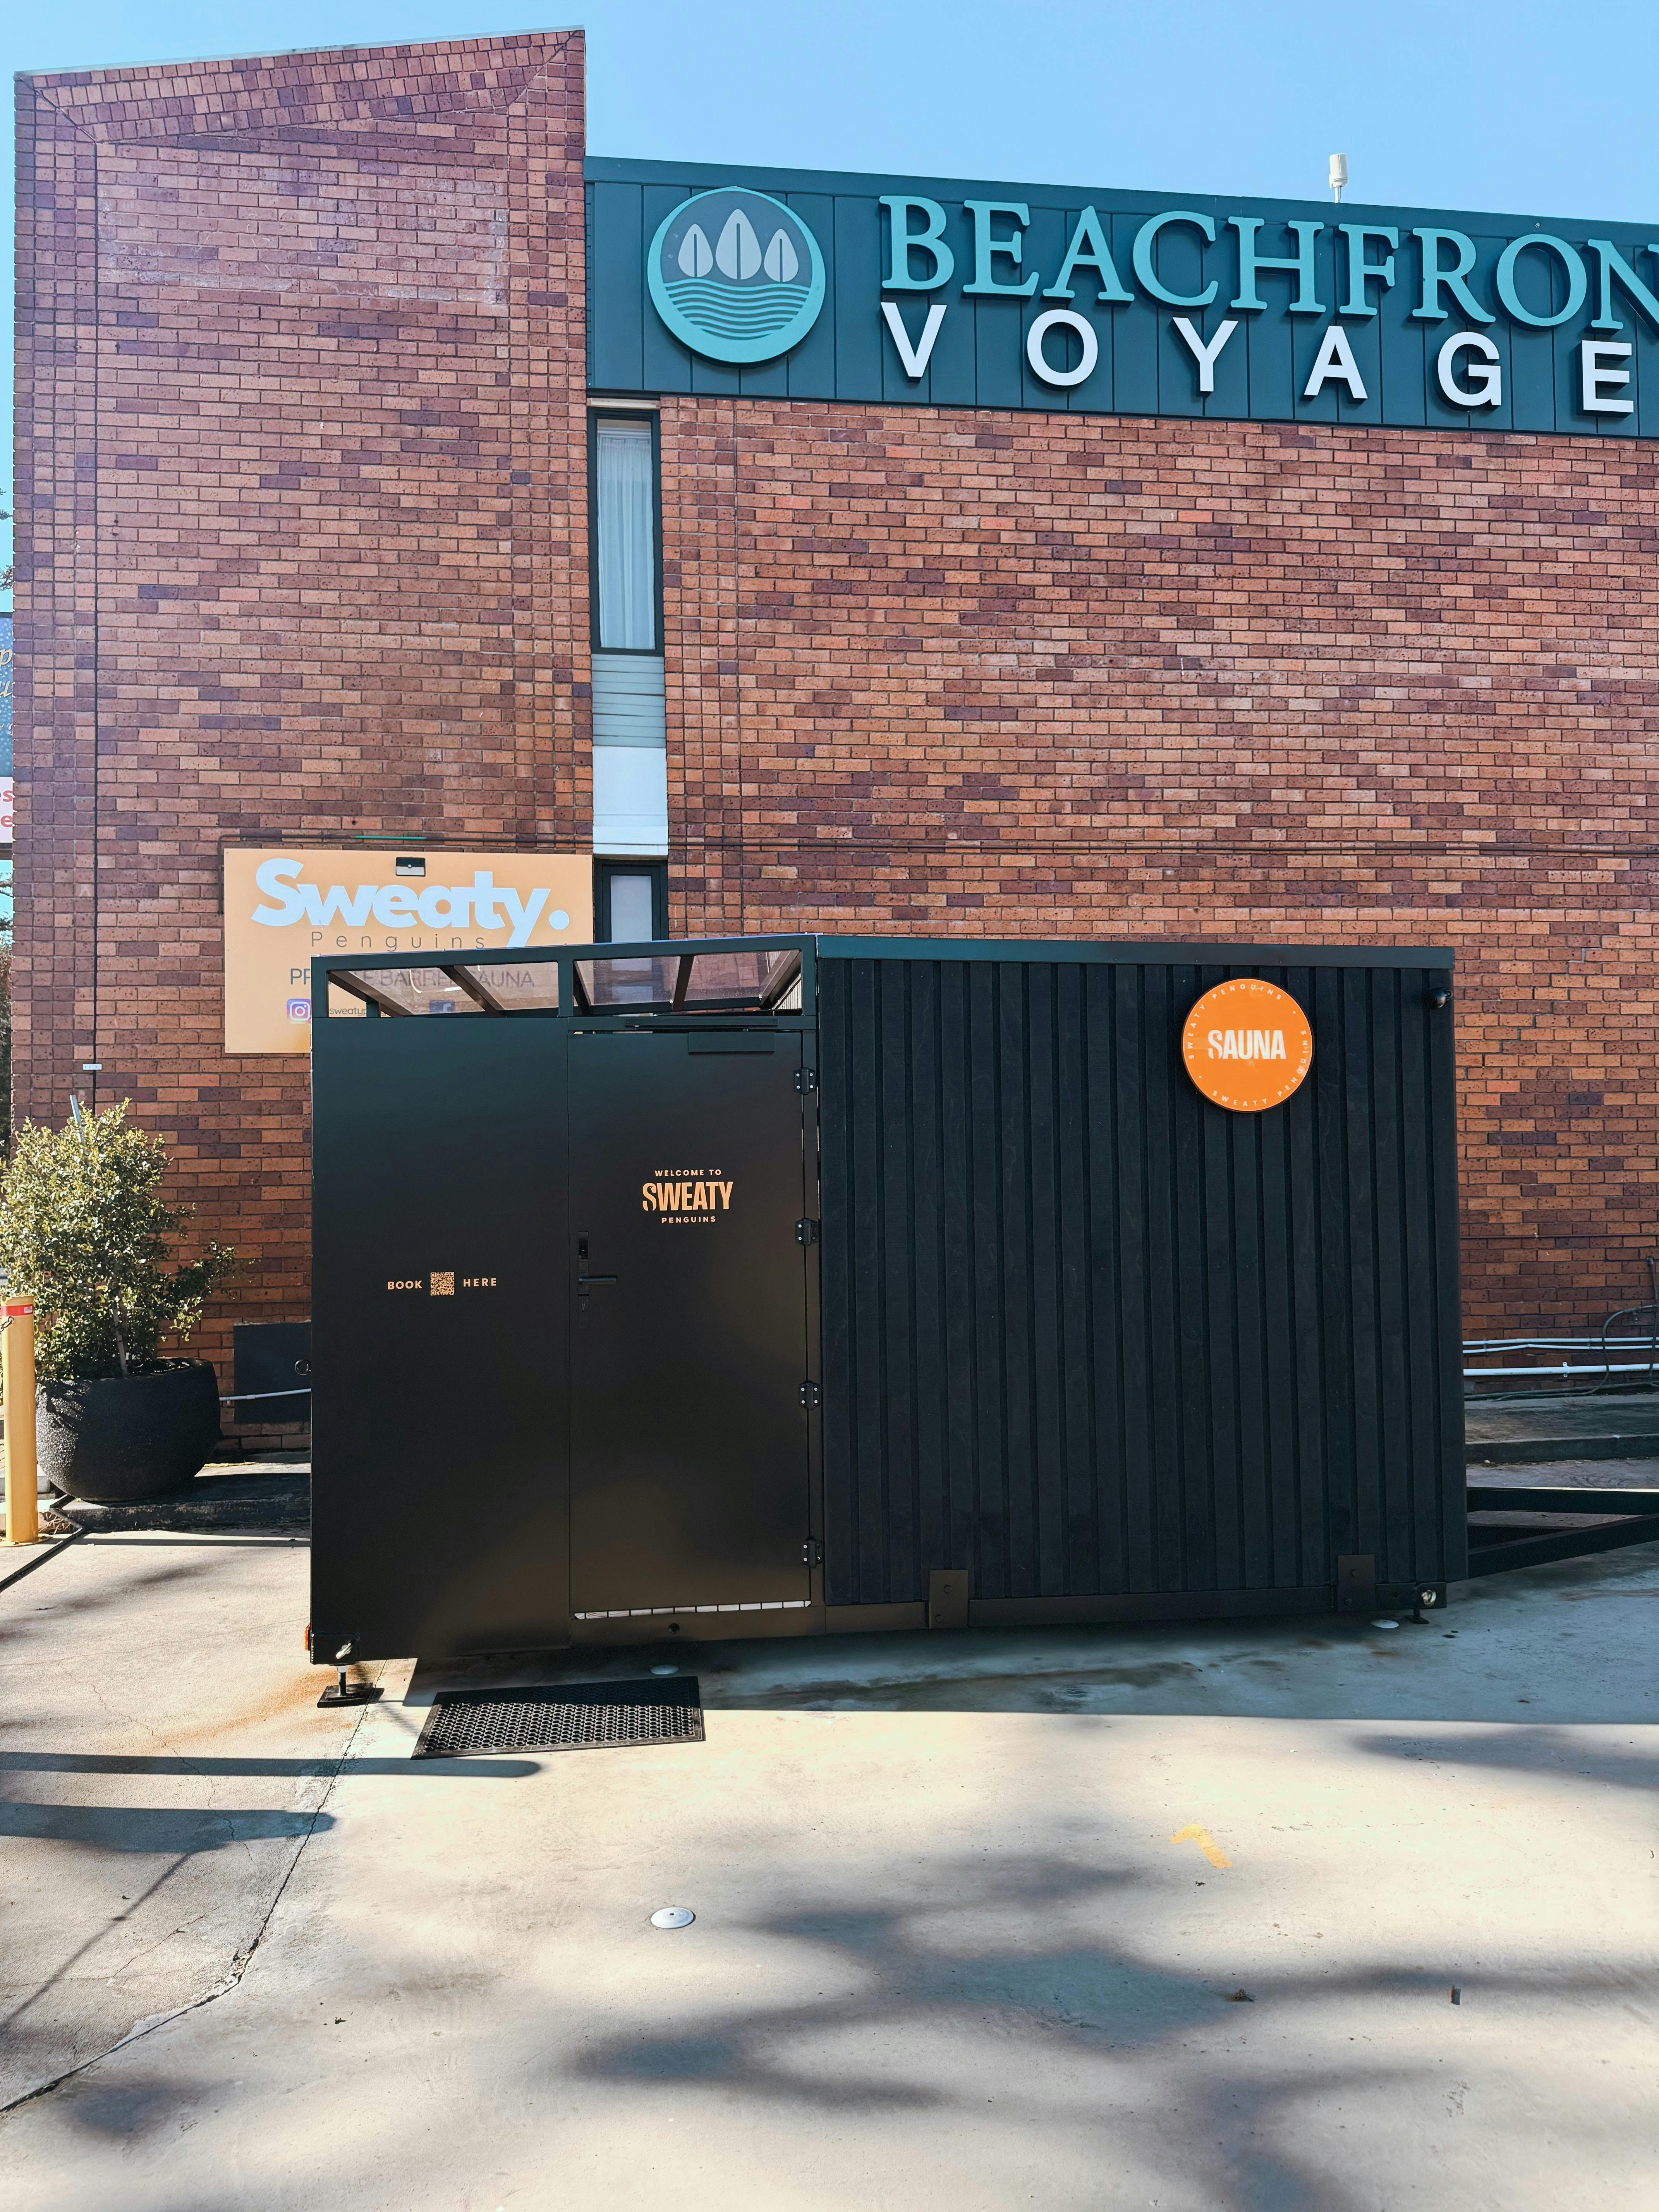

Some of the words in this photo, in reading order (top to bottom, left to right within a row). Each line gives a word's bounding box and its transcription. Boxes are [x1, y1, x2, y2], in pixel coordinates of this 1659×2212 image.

[881, 301, 1634, 414] VOYAGE
[311, 931, 485, 951] Penguins
[471, 970, 534, 987] AUNA
[1187, 1005, 1206, 1059] SWEATY
[1212, 984, 1282, 1000] PENGUINS
[1208, 1030, 1286, 1060] SAUNA
[1212, 1090, 1267, 1106] SWEATY
[642, 1181, 733, 1211] SWEATY
[387, 1280, 422, 1290] BOOK
[463, 1278, 497, 1287] HERE
